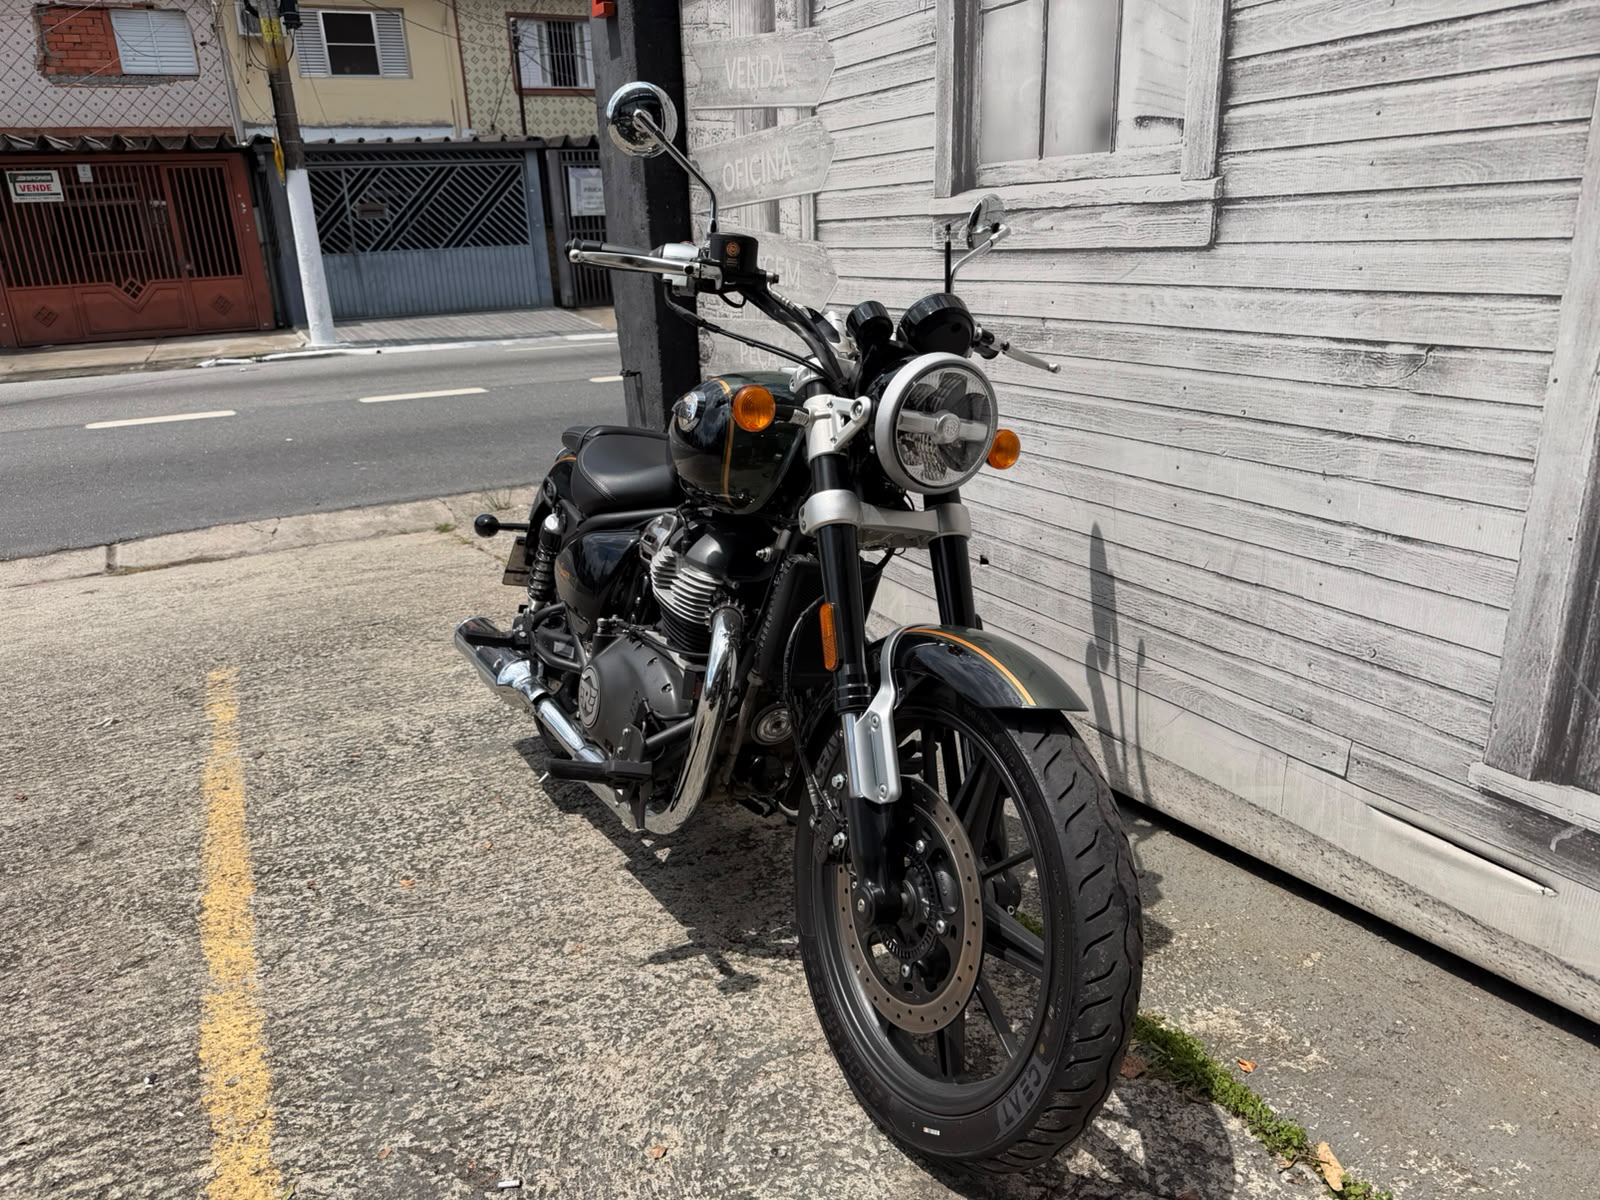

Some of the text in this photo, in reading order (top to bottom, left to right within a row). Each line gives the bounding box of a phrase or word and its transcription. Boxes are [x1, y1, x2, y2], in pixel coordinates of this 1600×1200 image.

[725, 53, 788, 90] VENDA
[18, 184, 53, 192] VENDE
[722, 146, 795, 192] OFICINA
[1002, 1062, 1043, 1126] CEAT
